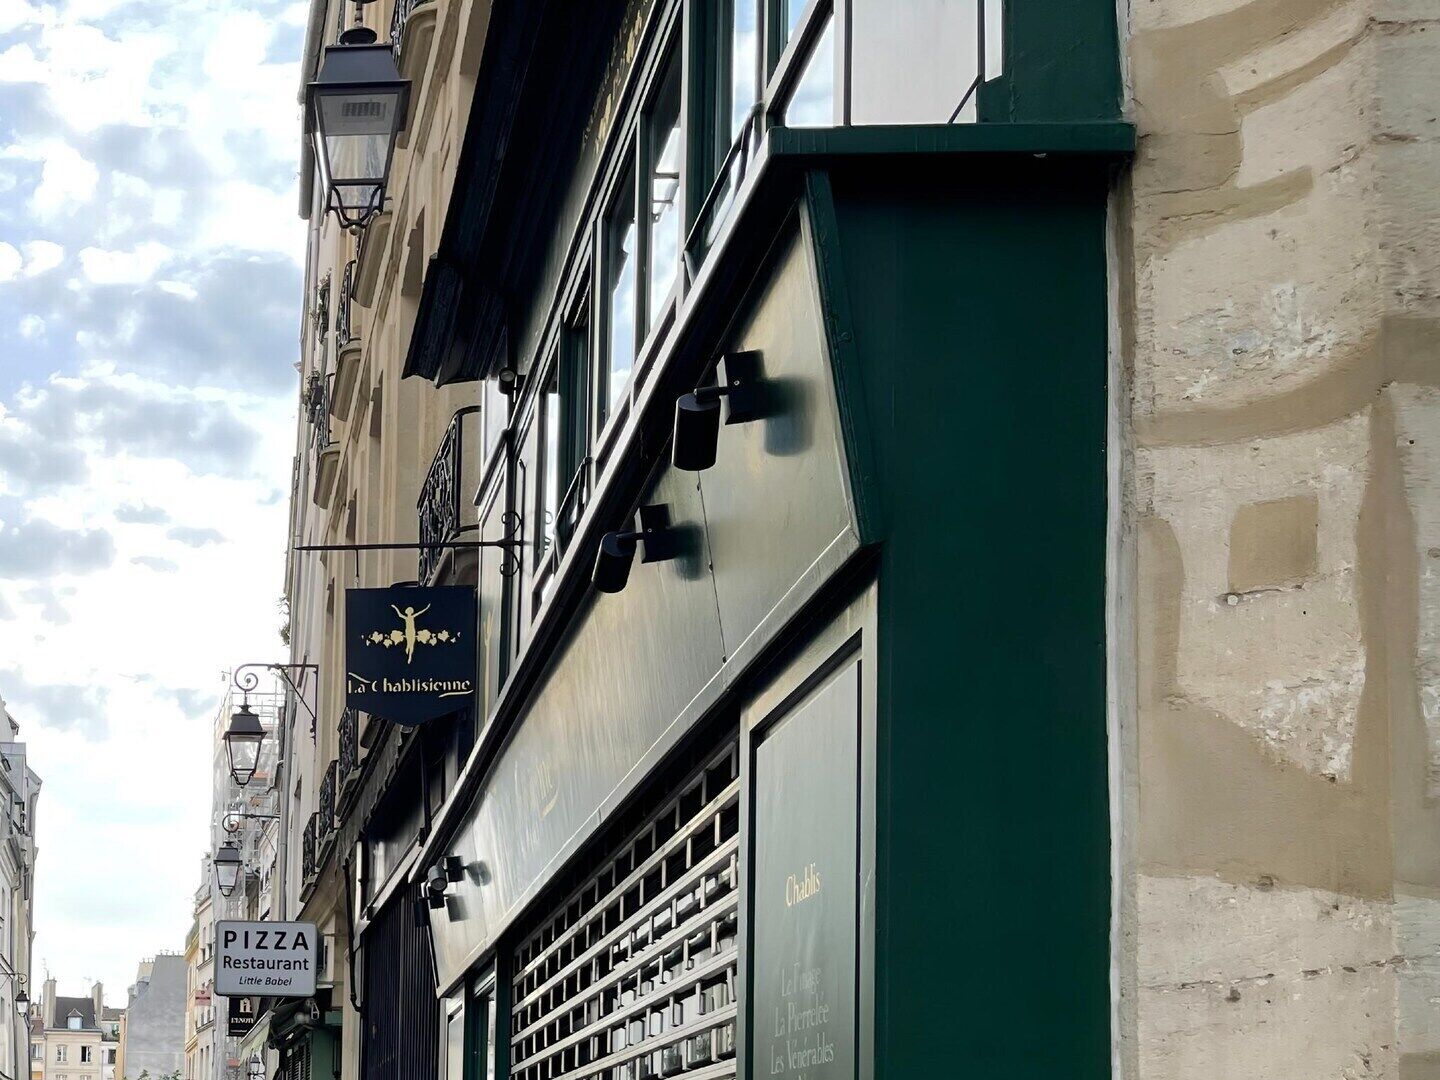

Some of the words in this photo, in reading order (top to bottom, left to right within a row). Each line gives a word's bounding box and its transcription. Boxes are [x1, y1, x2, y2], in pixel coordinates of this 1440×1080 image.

[371, 677, 472, 695] Chablisienne
[785, 862, 822, 907] Chablis
[224, 930, 309, 951] PIZZA
[223, 955, 309, 970] Restaurant
[239, 976, 263, 985] Little
[265, 977, 292, 986] Babel
[774, 1007, 786, 1037] La
[770, 1045, 784, 1075] Les
[787, 1032, 834, 1071] Vénérables
